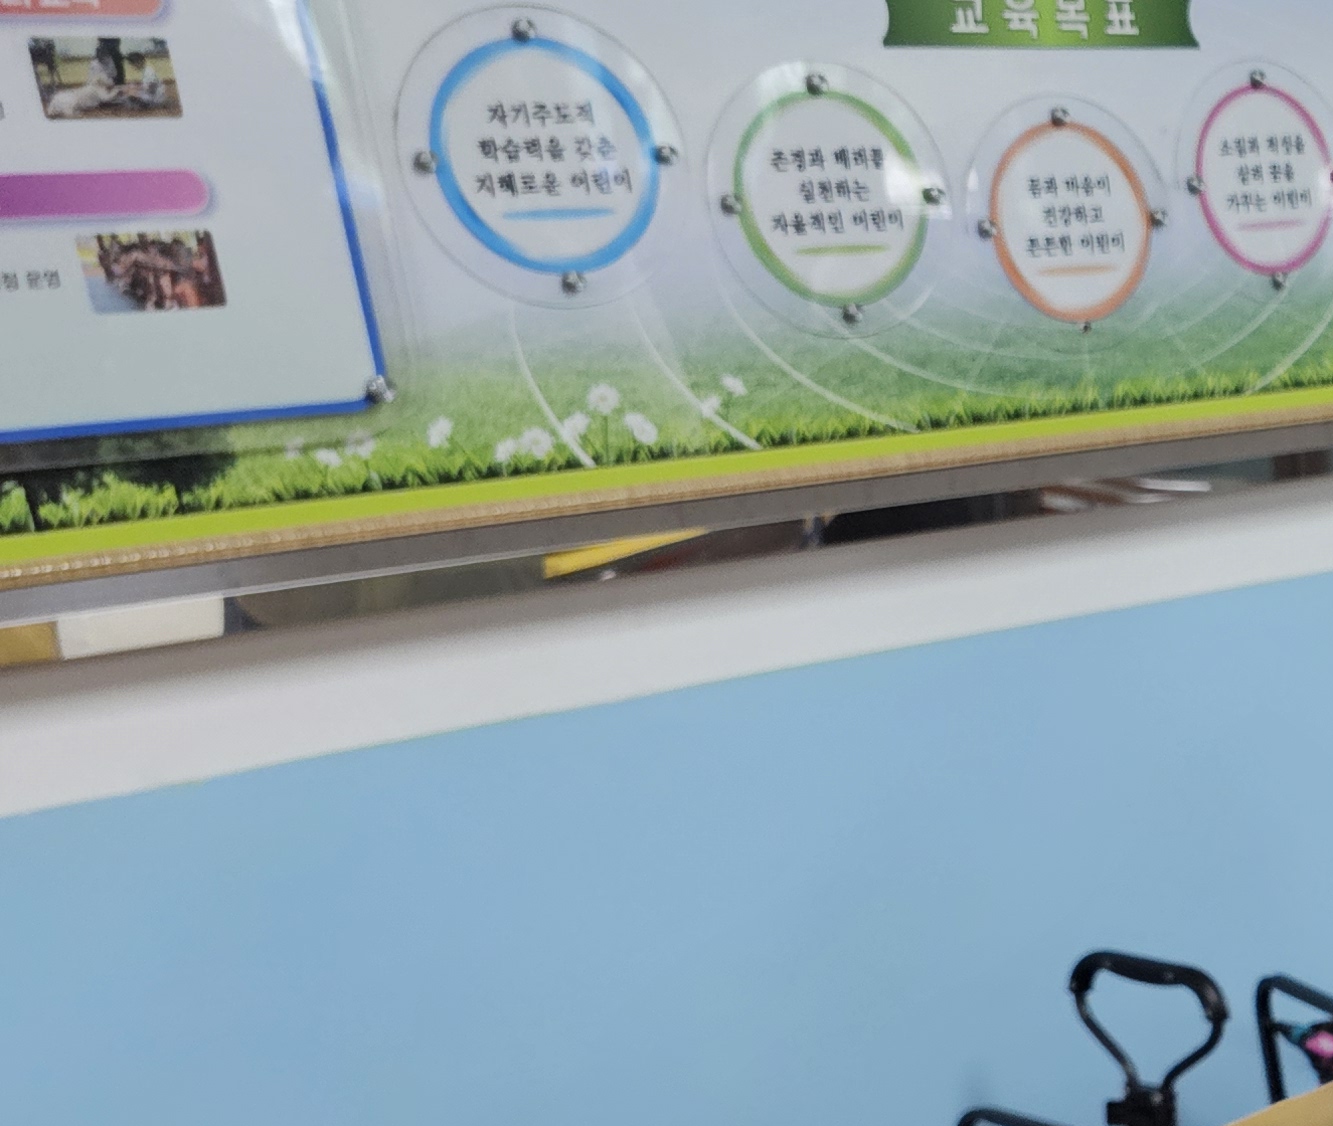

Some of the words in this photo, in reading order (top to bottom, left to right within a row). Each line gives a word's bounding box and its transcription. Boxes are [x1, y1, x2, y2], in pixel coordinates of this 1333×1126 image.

[487, 101, 595, 128] 자기주도적
[477, 135, 565, 163] 학습력을
[475, 169, 560, 197] 지혜로운
[569, 166, 633, 196] 어린이
[799, 176, 871, 204] 실천하는
[1273, 188, 1312, 210] 어린이
[851, 208, 904, 234] 어린이
[1079, 230, 1125, 255] 어린이
